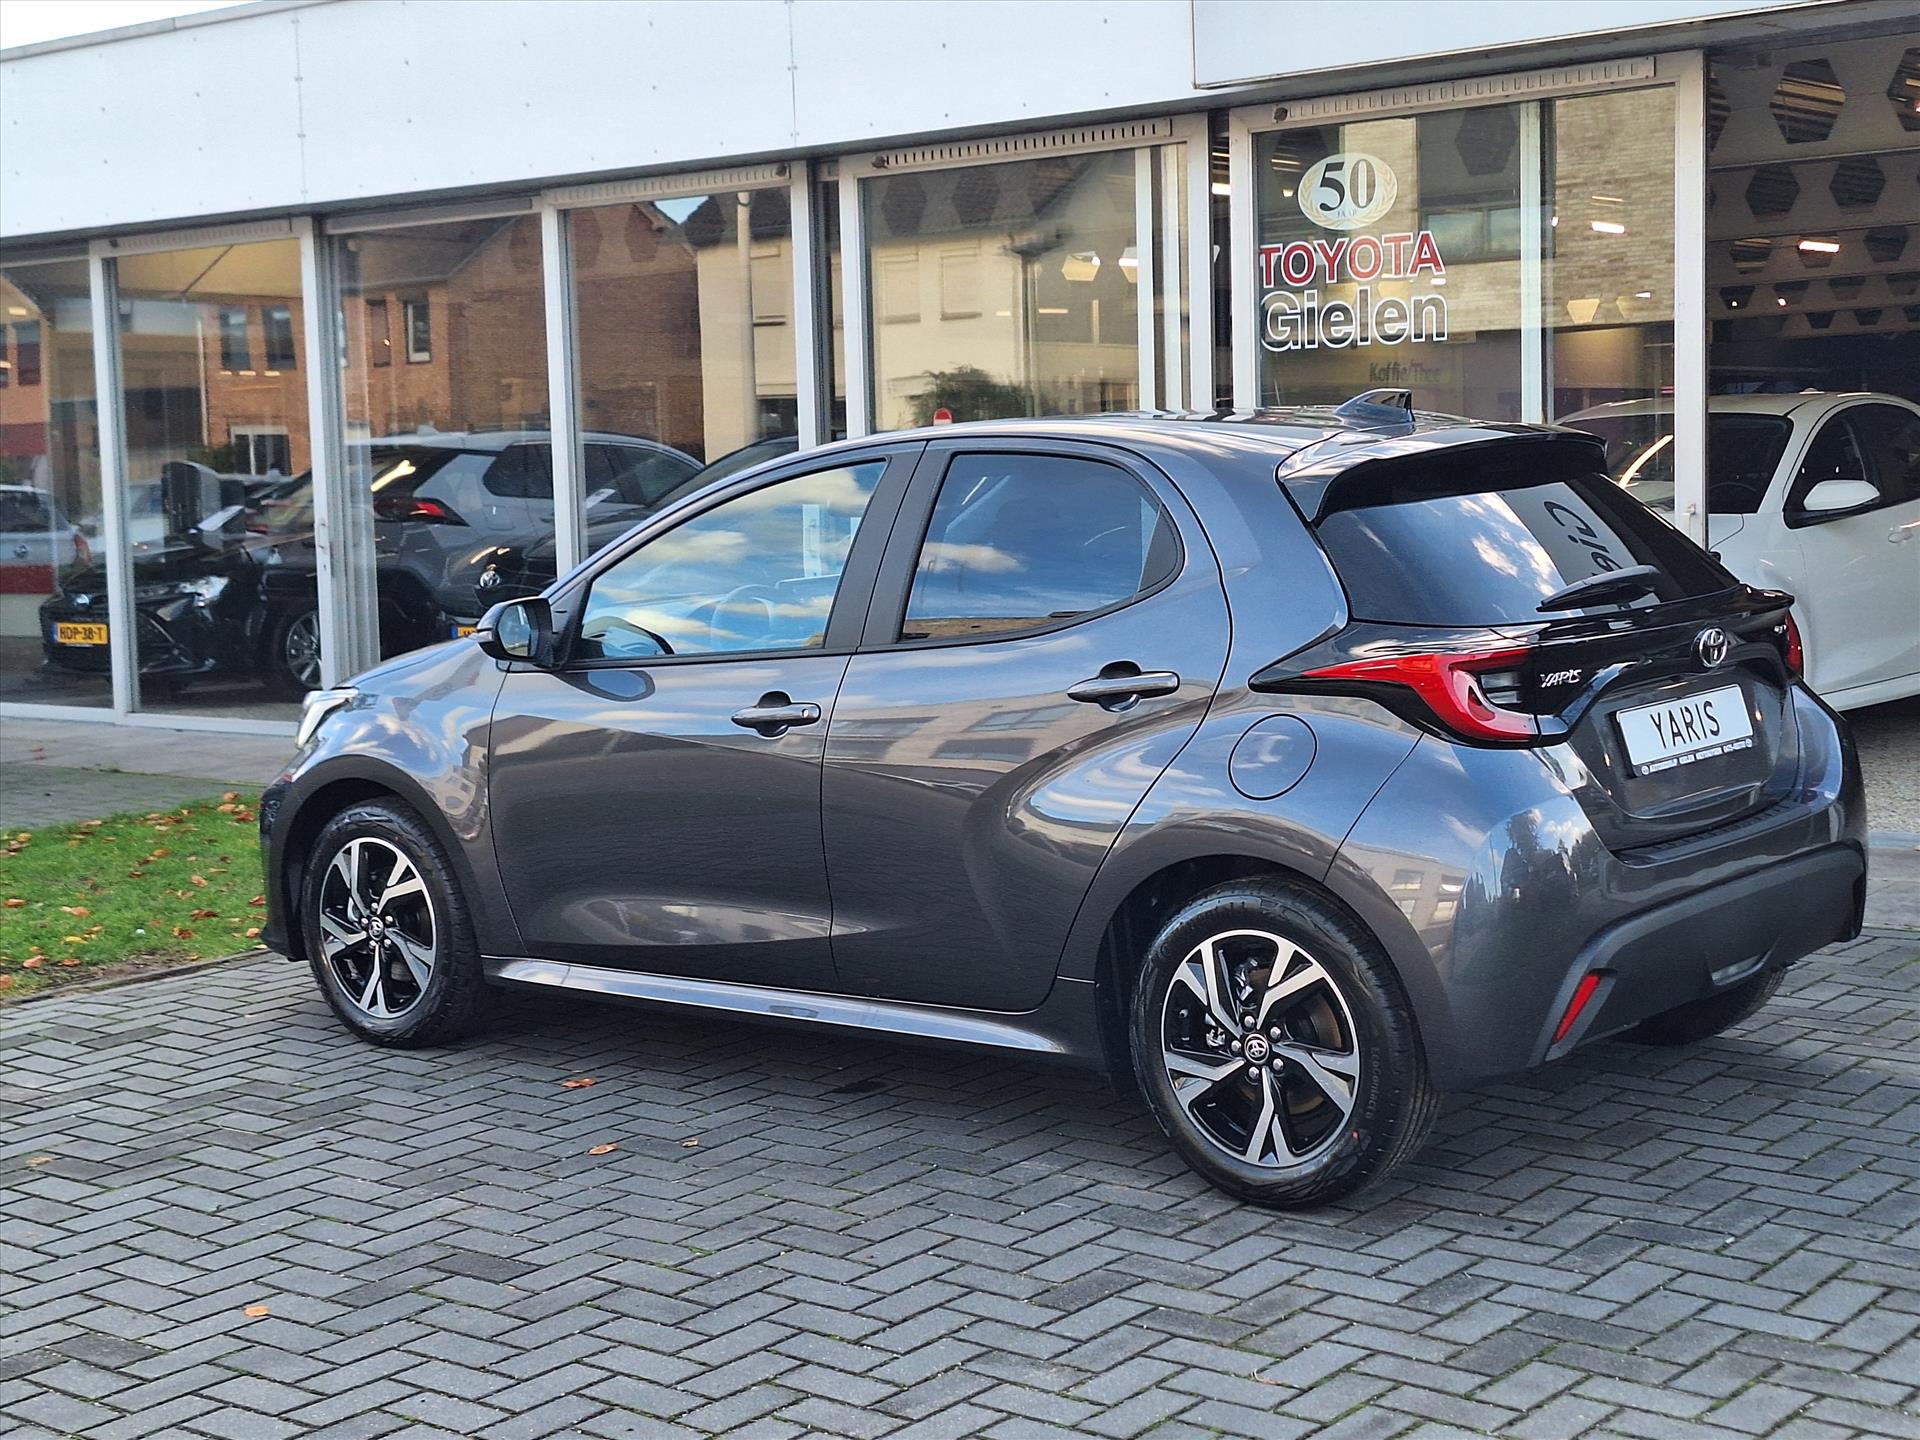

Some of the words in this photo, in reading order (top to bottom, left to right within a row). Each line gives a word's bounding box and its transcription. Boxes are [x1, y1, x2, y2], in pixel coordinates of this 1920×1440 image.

[1320, 159, 1376, 212] 50
[1260, 231, 1446, 288] TOYOTA
[1261, 286, 1448, 352] Gielen
[1540, 669, 1582, 688] YARIS
[1650, 700, 1720, 749] YARIS
